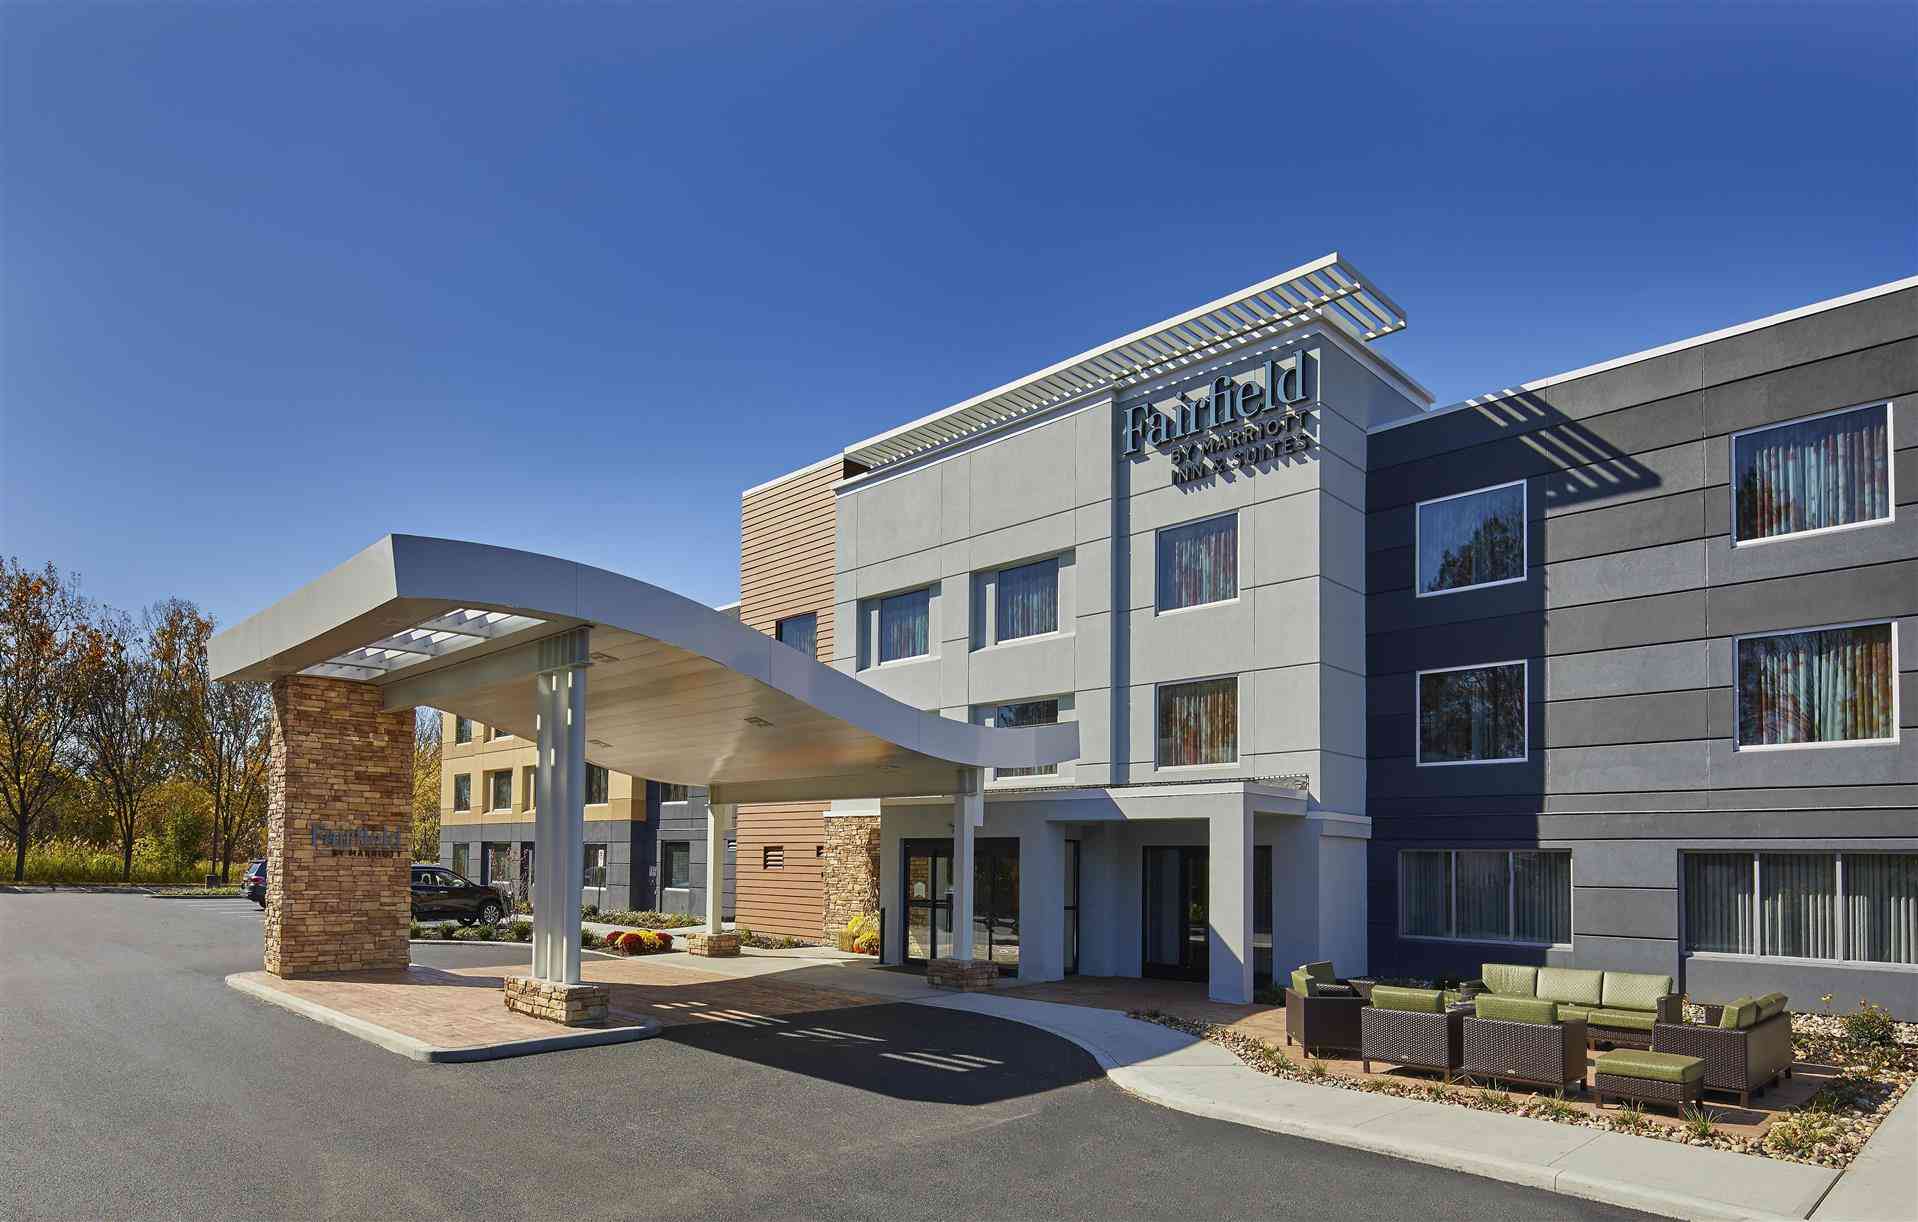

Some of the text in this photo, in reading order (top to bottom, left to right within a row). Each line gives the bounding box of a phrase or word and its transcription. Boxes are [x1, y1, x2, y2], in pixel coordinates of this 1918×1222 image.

[1121, 347, 1309, 456] Fairfield
[1171, 409, 1310, 463] BY MARRIOTT
[1171, 459, 1205, 485] INN
[1231, 432, 1309, 469] SUITES
